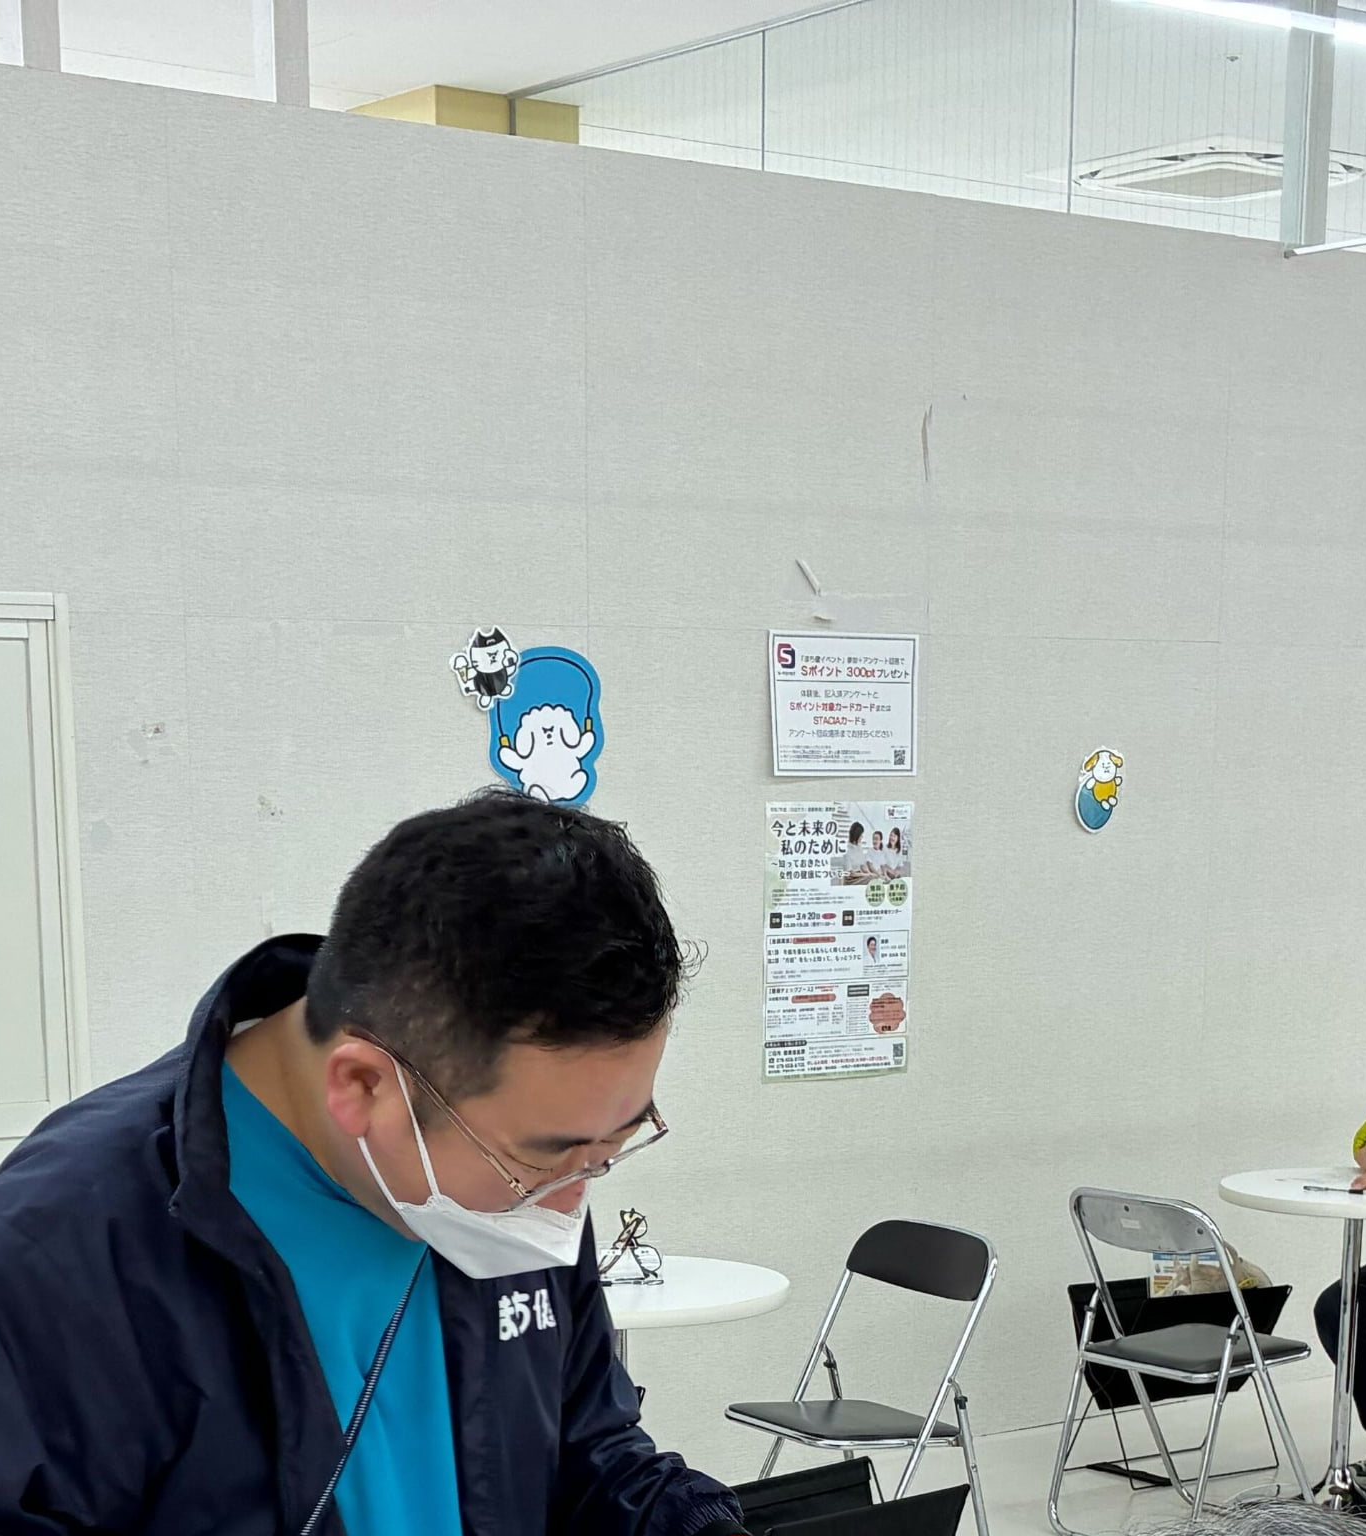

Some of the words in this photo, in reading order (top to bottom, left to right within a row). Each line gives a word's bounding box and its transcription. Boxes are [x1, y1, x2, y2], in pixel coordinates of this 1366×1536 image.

[801, 666, 842, 677] Sポイント
[771, 820, 838, 837] 今と未来の
[781, 839, 847, 855] 私のために
